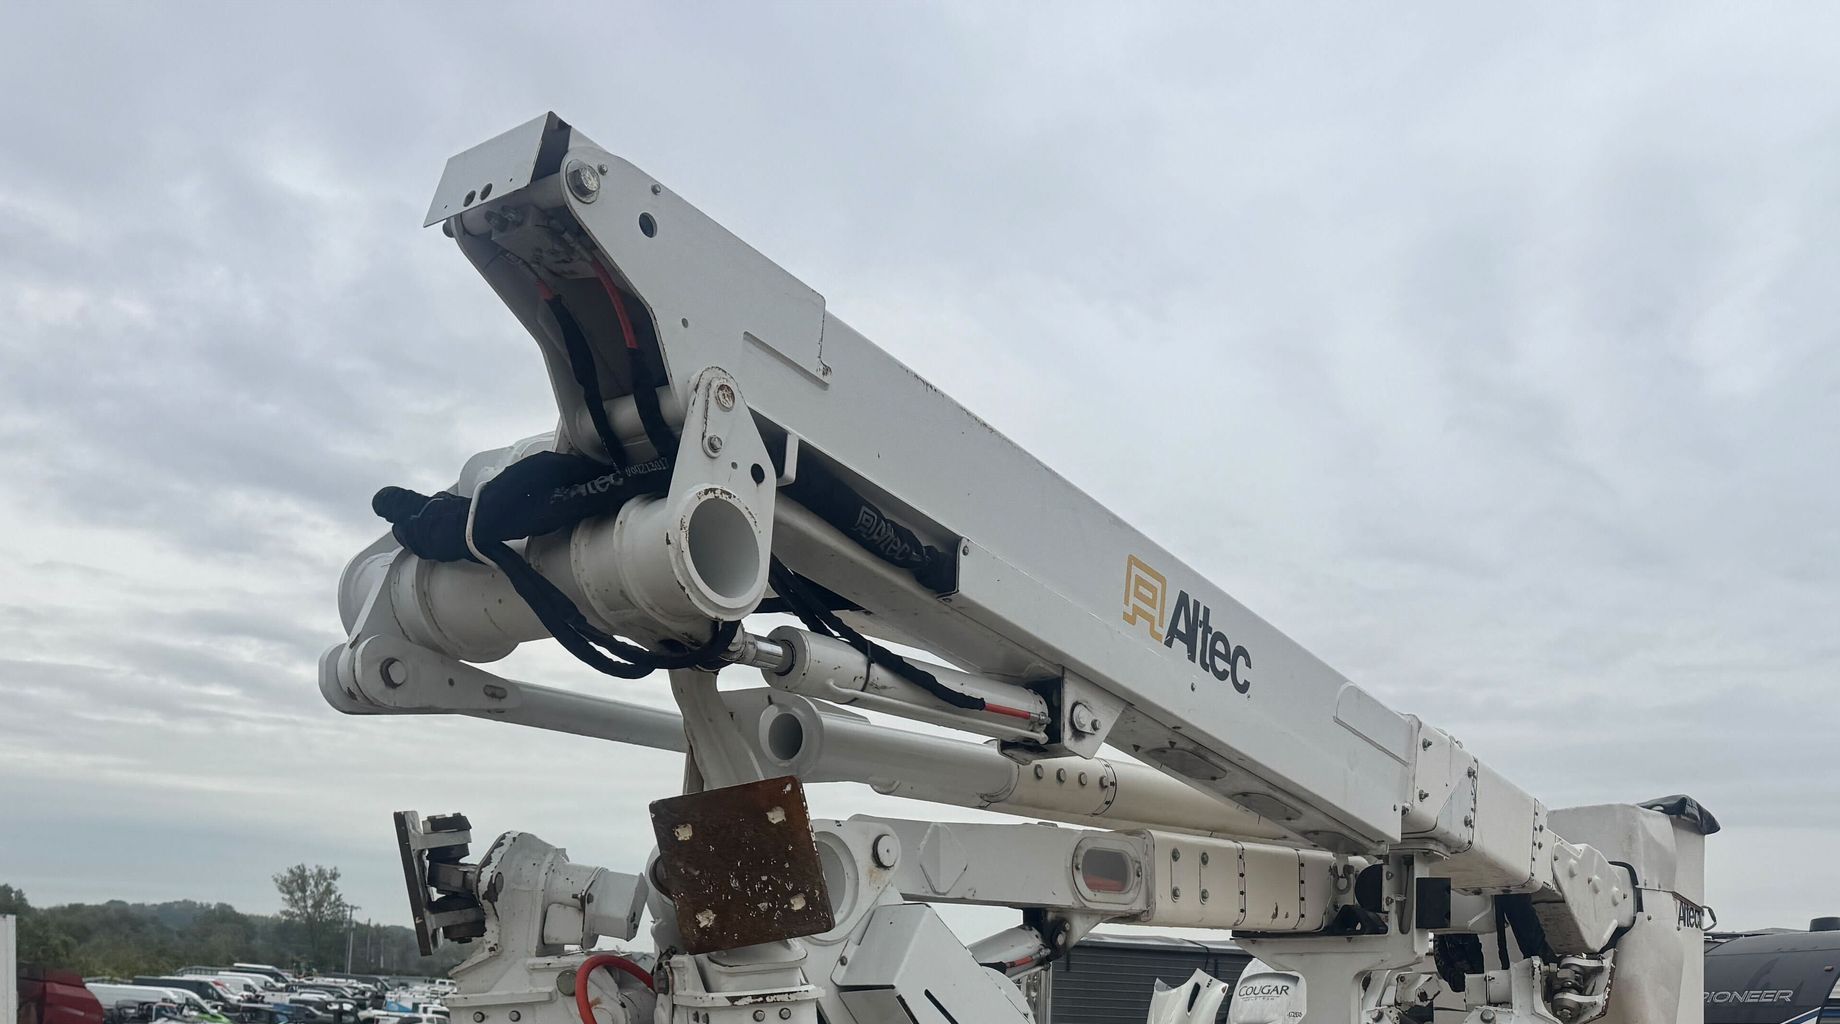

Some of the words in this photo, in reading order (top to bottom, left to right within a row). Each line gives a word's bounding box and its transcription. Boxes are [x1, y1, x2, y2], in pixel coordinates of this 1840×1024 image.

[1163, 589, 1252, 695] Altec
[1678, 901, 1702, 928] Altec
[1238, 984, 1290, 997] COUGAR
